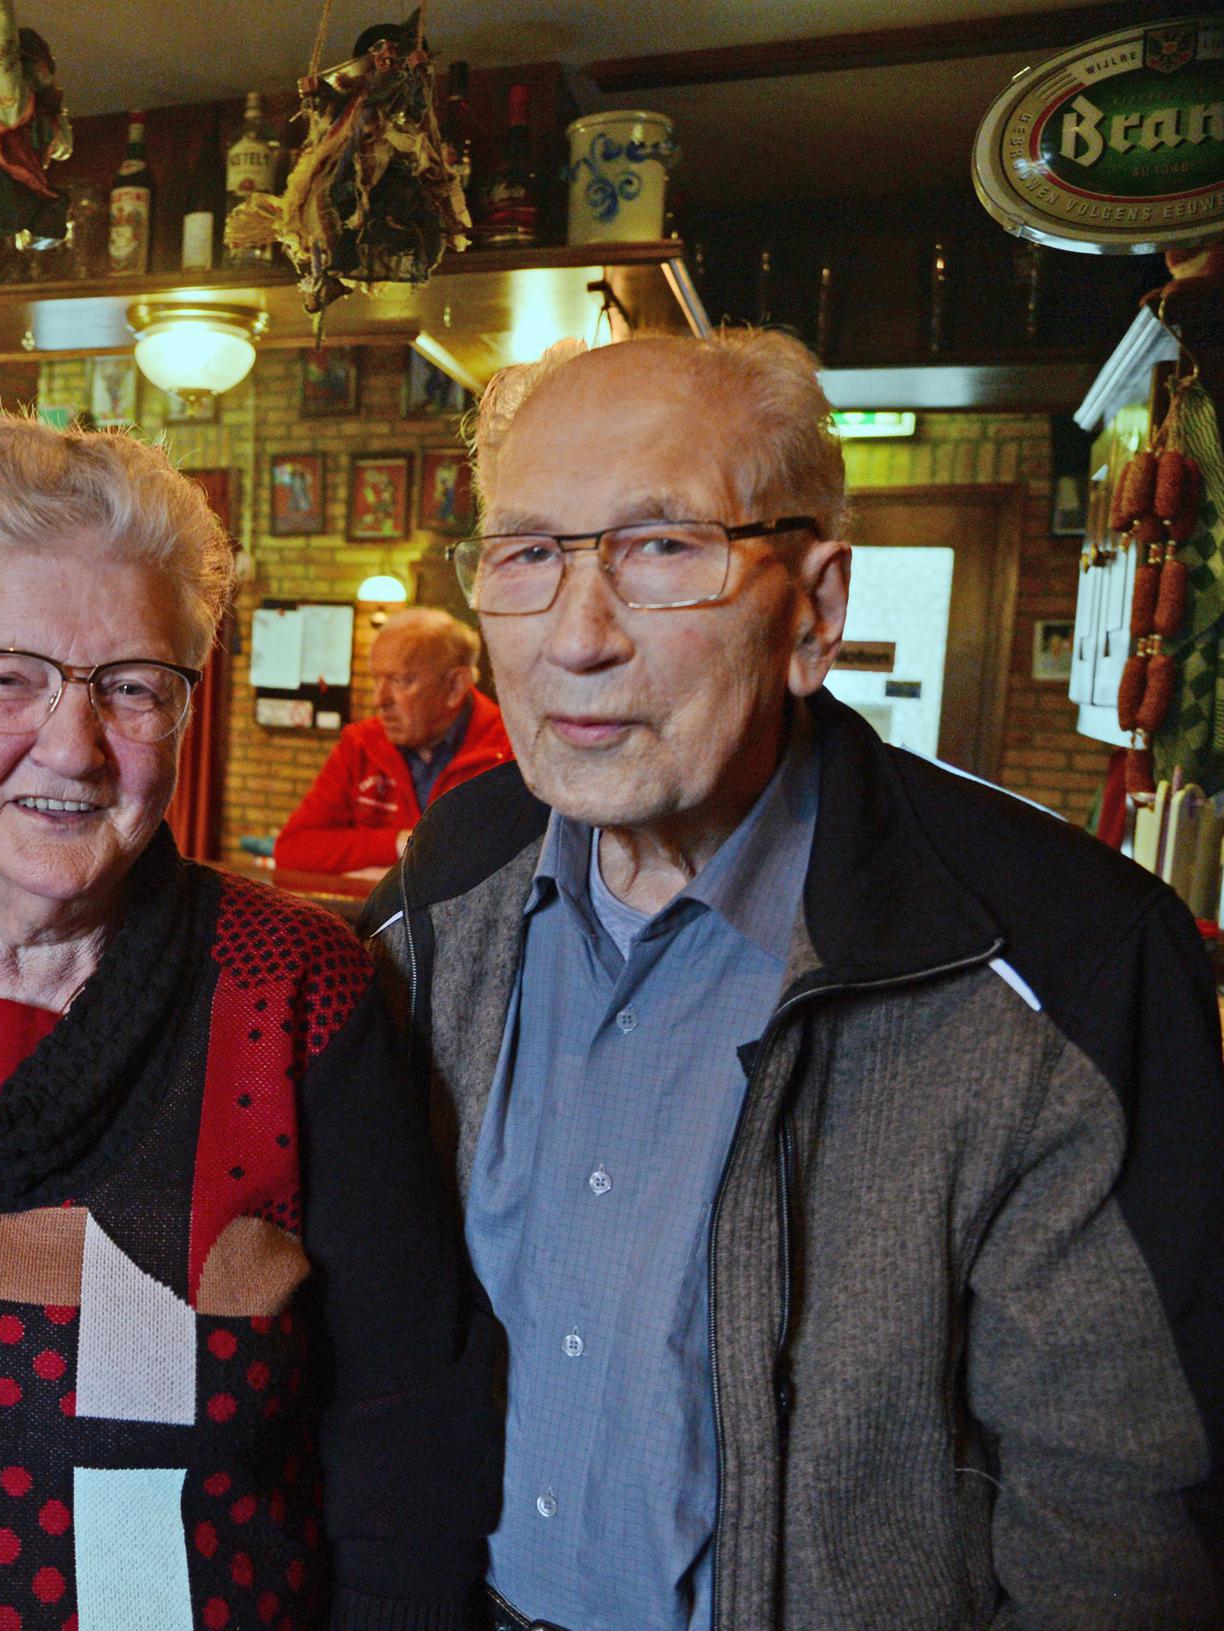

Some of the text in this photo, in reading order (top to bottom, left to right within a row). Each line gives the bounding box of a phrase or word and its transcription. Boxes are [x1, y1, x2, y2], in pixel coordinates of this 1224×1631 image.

[1084, 51, 1138, 75] WIJLRE
[1059, 95, 1224, 168] Bran
[1066, 201, 1153, 222] VOLGENS
